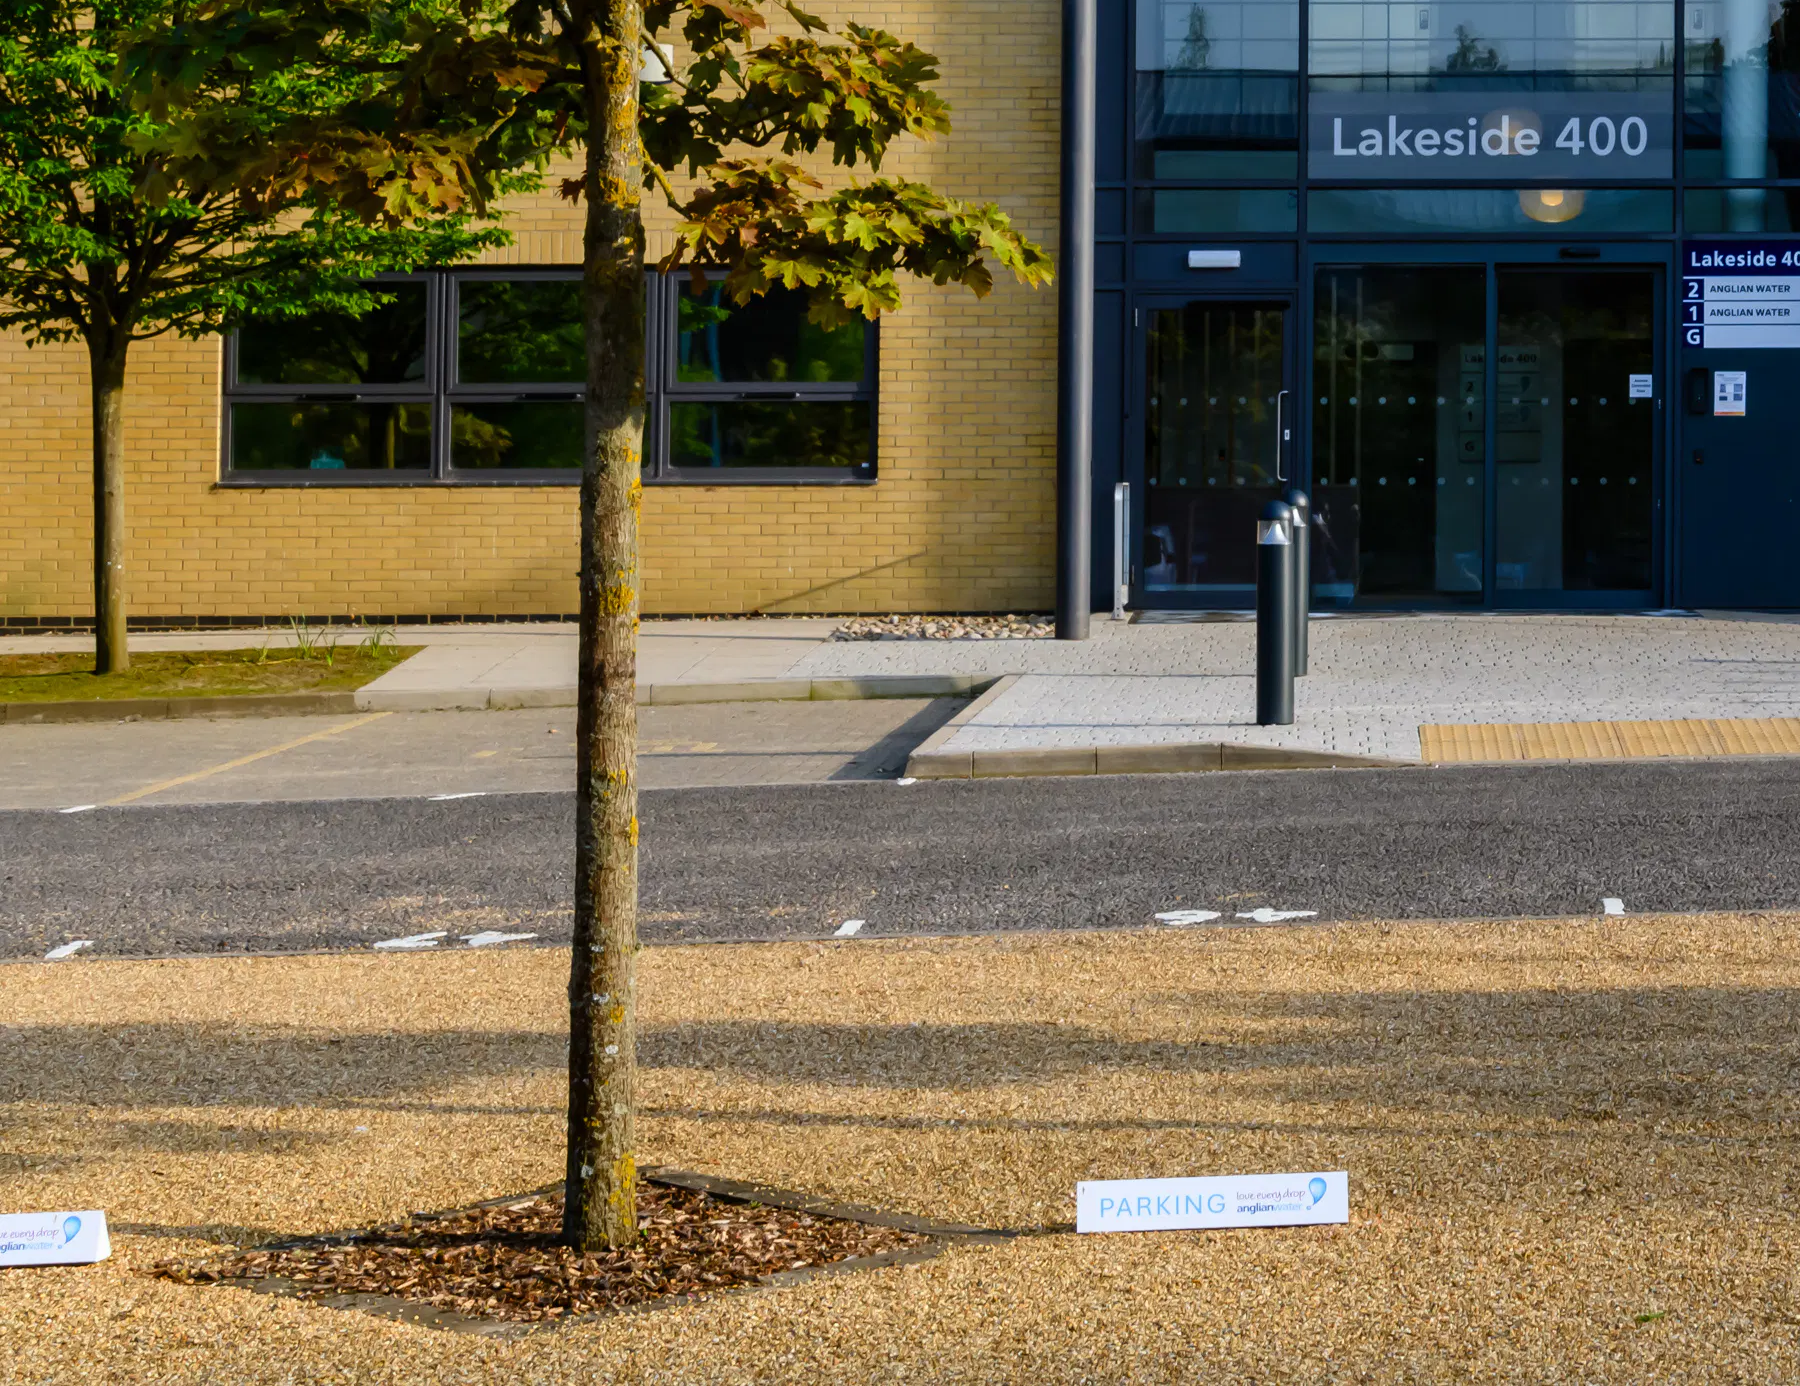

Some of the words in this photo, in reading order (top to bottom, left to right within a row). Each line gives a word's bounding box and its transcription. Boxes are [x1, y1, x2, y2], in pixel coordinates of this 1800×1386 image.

[1333, 115, 1541, 156] Lakeside
[1555, 116, 1648, 156] 400
[1691, 250, 1777, 267] Lakeside
[1688, 282, 1699, 298] 2
[1709, 285, 1754, 293] ANGLIAN
[1756, 285, 1791, 293] WATER
[1689, 305, 1698, 321] 1
[1709, 308, 1754, 317] ANGLIAN
[1756, 308, 1791, 317] WATER
[1686, 329, 1701, 345] G
[1517, 353, 1537, 363] 400
[1466, 381, 1474, 392] 2
[1464, 441, 1475, 452] G
[1236, 1191, 1255, 1200] love
[1256, 1191, 1281, 1202] every
[1282, 1188, 1306, 1201] drop
[1100, 1193, 1226, 1218] PARKING
[35, 1226, 60, 1240] drop
